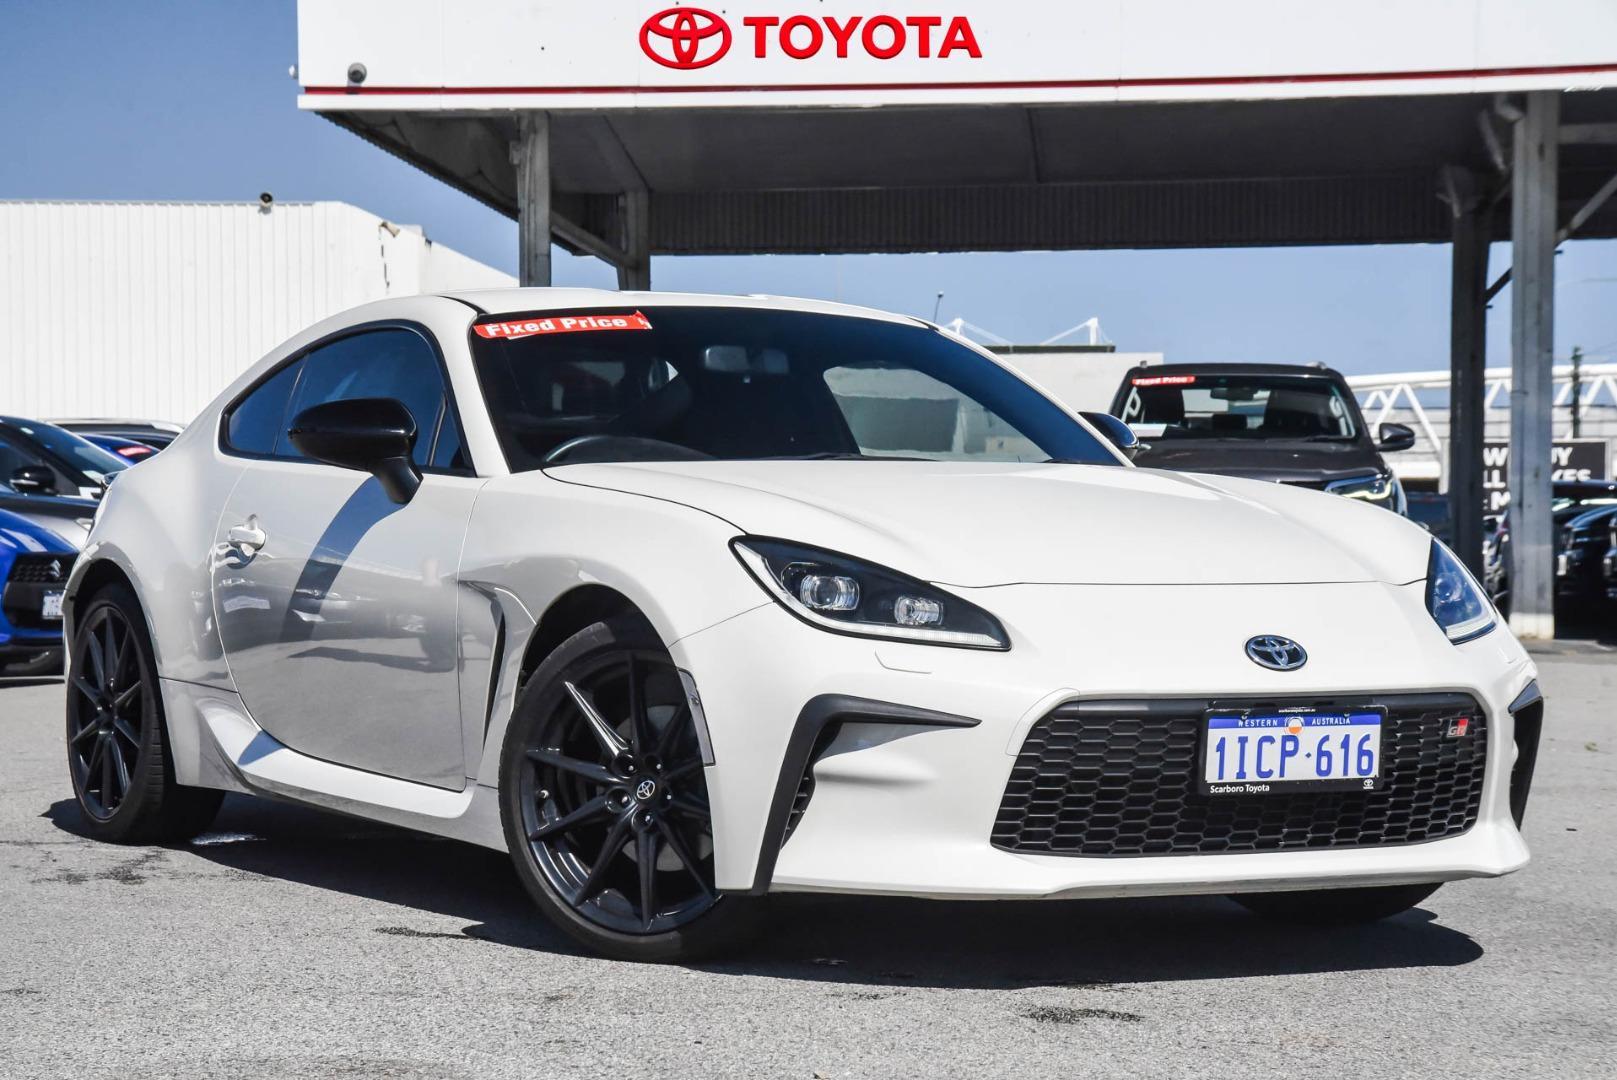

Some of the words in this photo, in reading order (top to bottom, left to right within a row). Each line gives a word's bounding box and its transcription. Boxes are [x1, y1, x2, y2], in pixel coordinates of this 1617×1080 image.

[743, 14, 983, 59] TOYOTA
[486, 319, 556, 336] Fixed
[559, 316, 627, 330] Price
[1238, 718, 1278, 727] WESTERN
[1311, 717, 1351, 726] AUSTRALIA
[1210, 784, 1244, 794] Scarboro
[1245, 783, 1270, 793] Toyota
